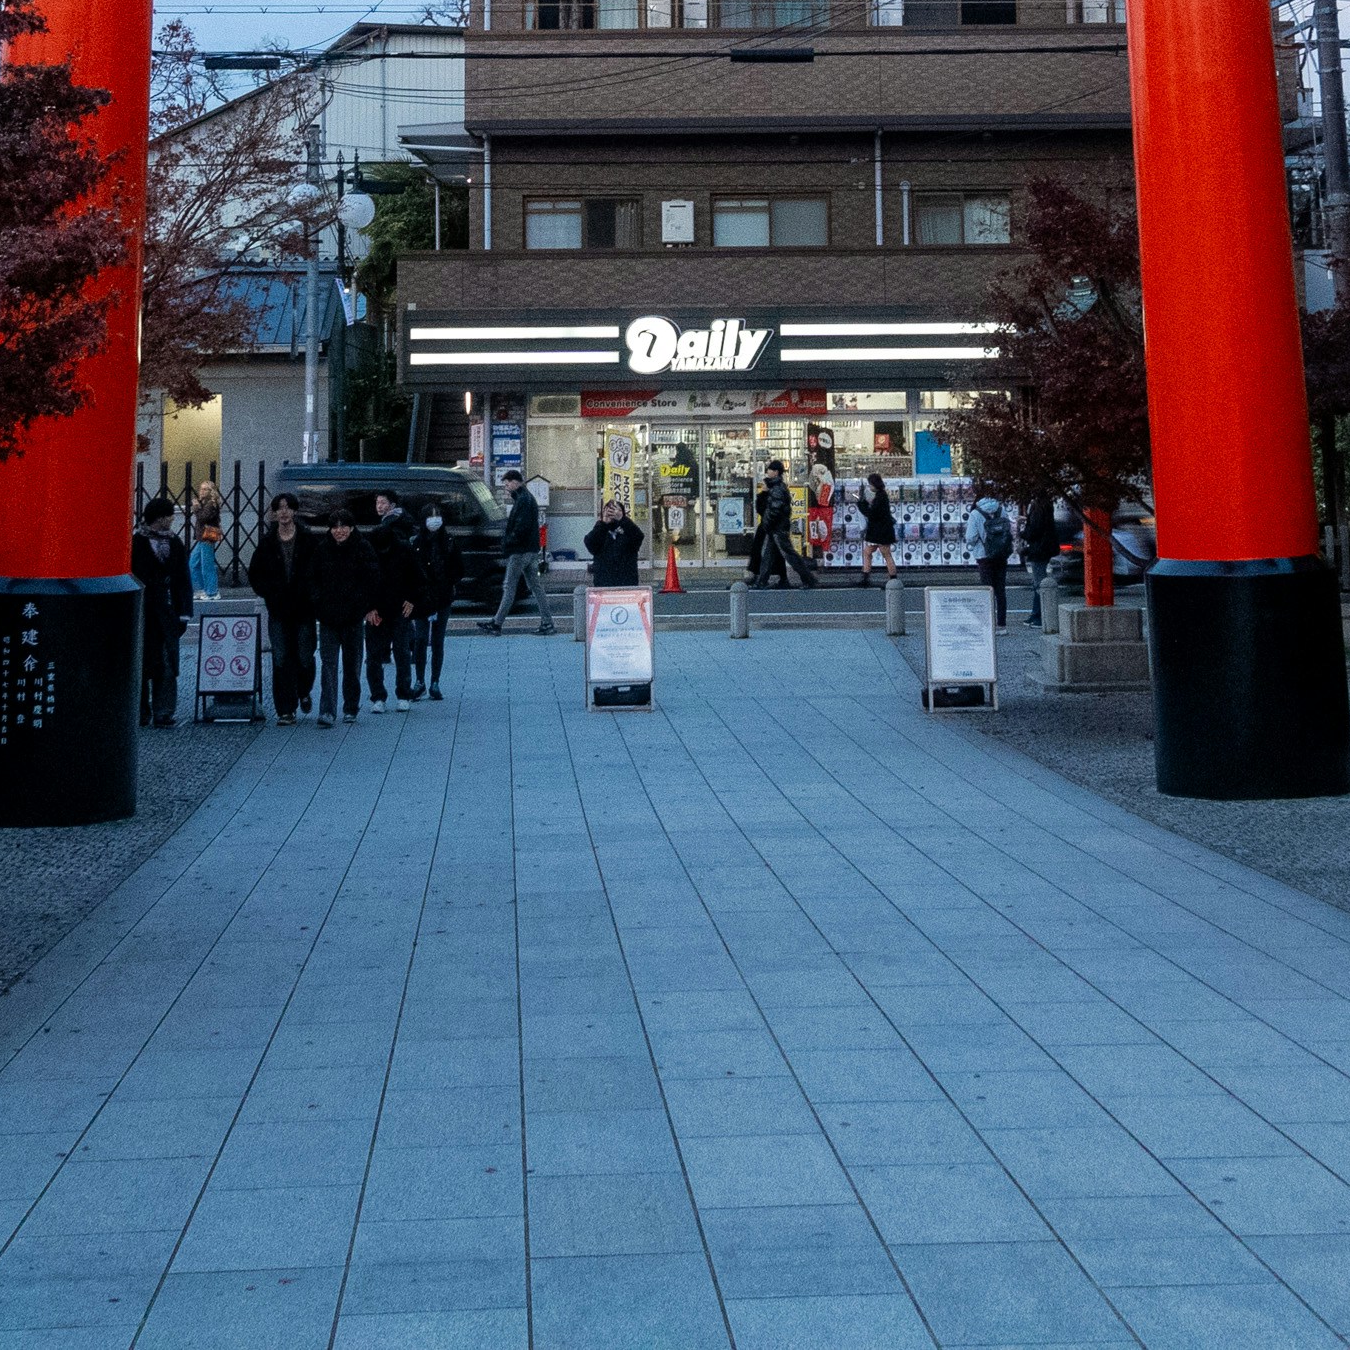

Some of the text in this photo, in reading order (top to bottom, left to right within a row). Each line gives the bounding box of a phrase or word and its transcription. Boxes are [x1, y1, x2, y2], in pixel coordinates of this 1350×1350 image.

[626, 316, 773, 374] Daily
[670, 356, 736, 371] YAMAZAKI
[586, 399, 677, 408] Convenience Store
[660, 463, 690, 477] Daily
[623, 475, 632, 518] MONEY
